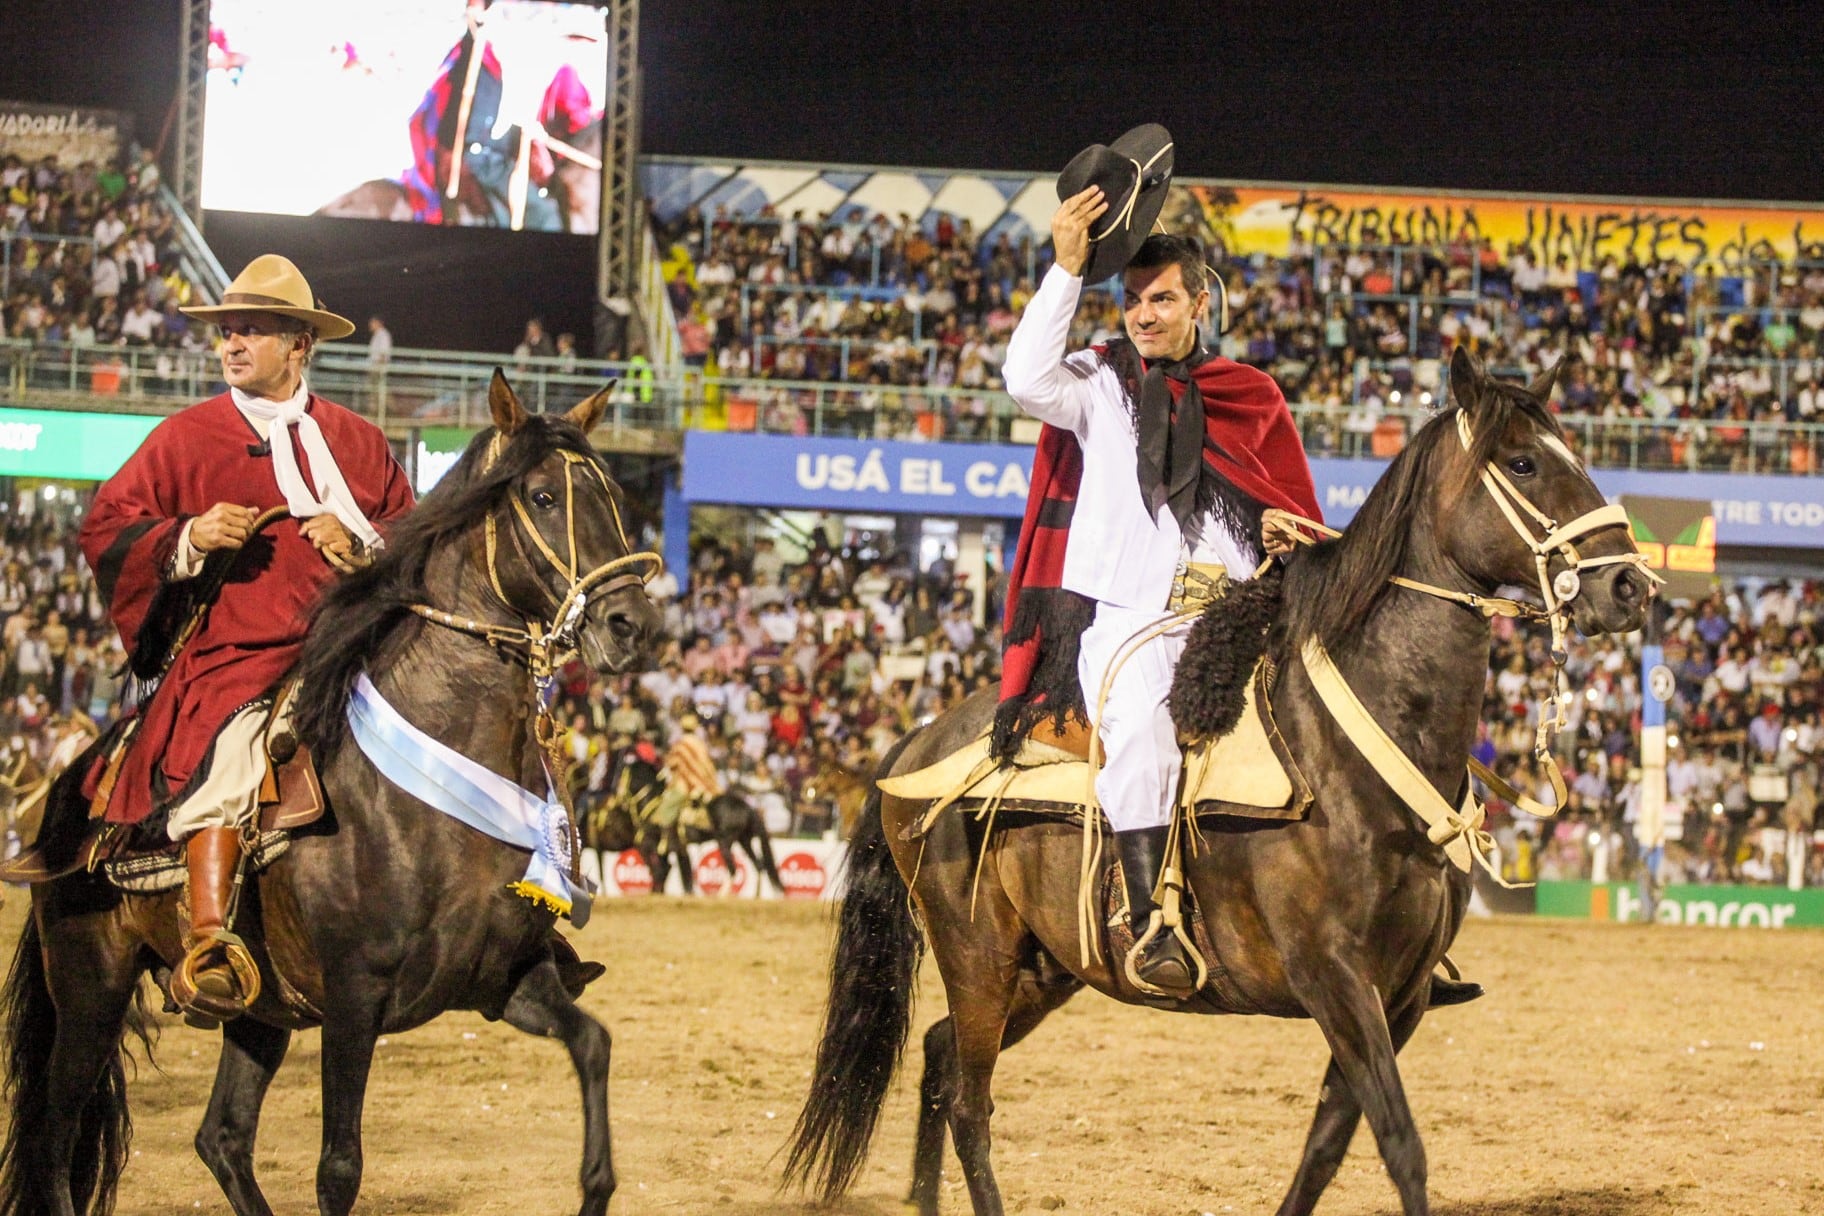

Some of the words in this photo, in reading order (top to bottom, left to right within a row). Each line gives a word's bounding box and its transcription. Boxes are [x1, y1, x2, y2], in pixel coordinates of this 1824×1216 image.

[796, 449, 889, 492] USÁ
[902, 460, 957, 496] EL
[964, 462, 1032, 499] CA
[1327, 485, 1373, 510] MA
[1711, 500, 1762, 525] TRE
